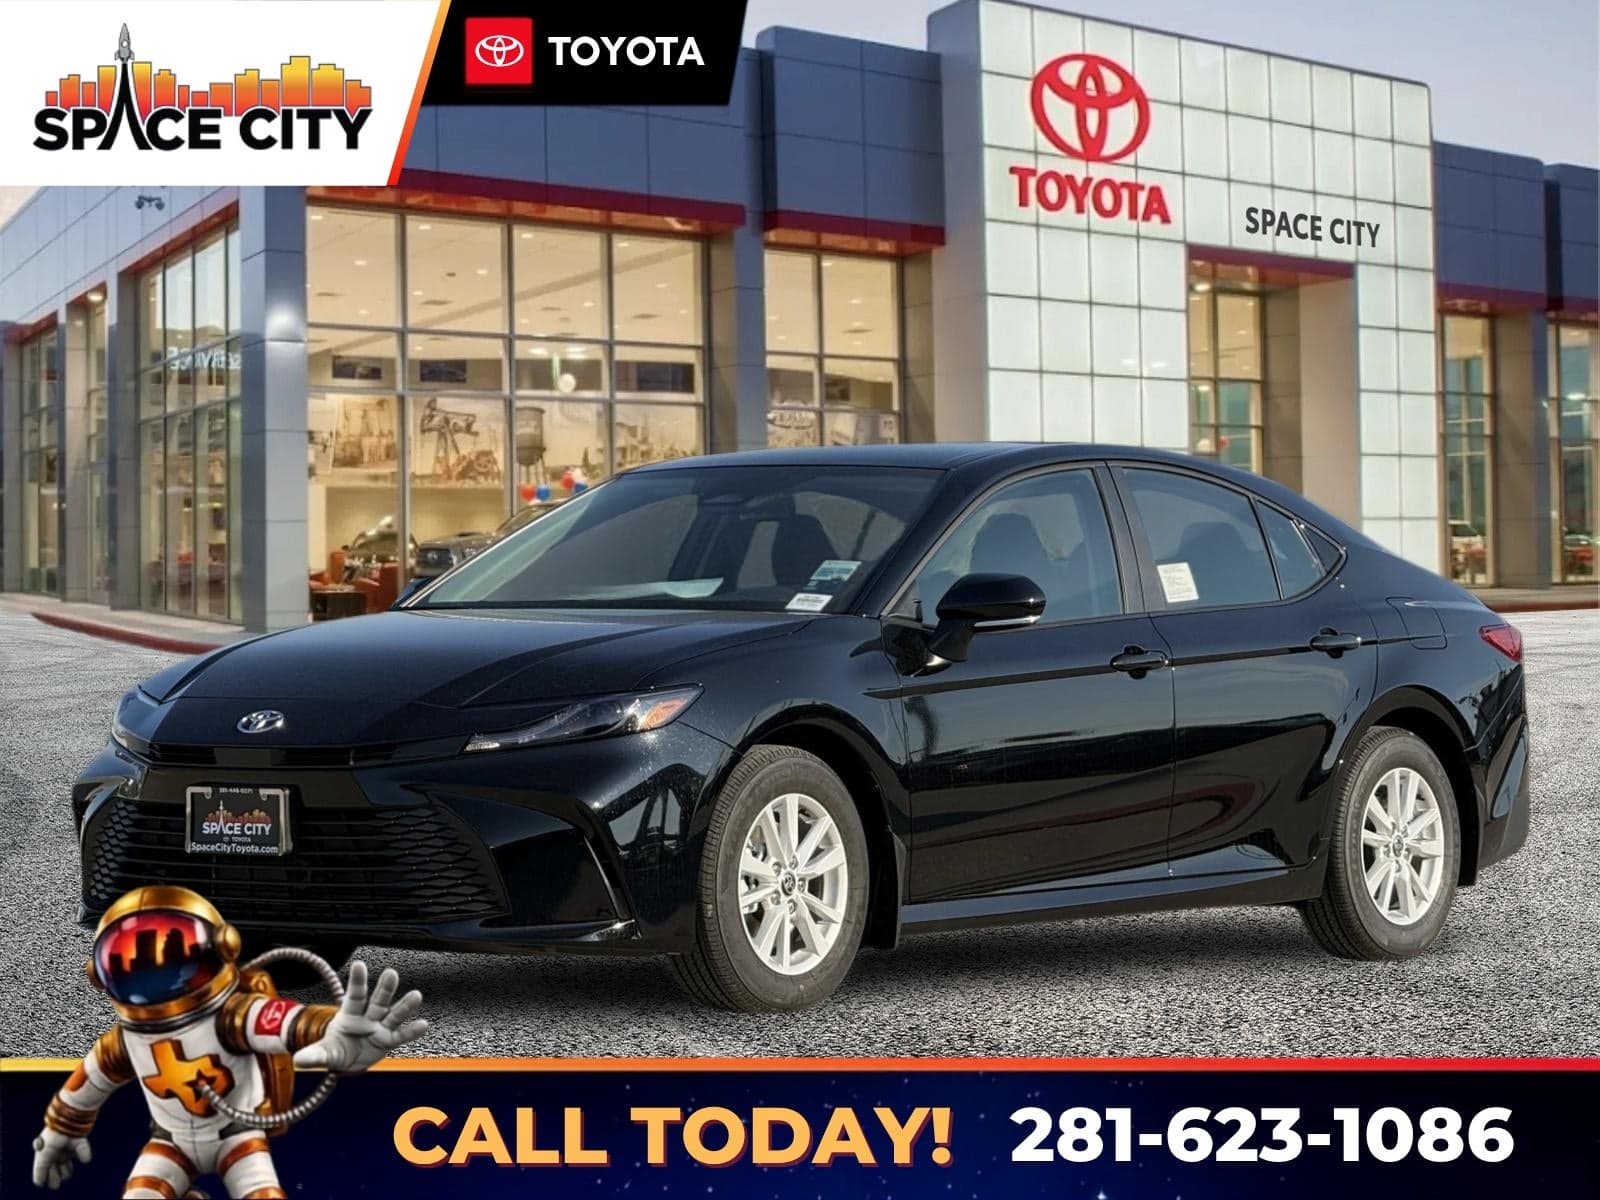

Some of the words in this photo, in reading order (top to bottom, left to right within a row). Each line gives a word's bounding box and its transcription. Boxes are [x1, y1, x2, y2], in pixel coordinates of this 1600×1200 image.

[1009, 165, 1171, 225] TOYOTA
[1245, 206, 1323, 242] SPACE
[1329, 217, 1381, 248] CITY
[202, 822, 242, 835] SPACE
[244, 823, 272, 835] CITY
[191, 842, 279, 854] SpaceCityToyota.com
